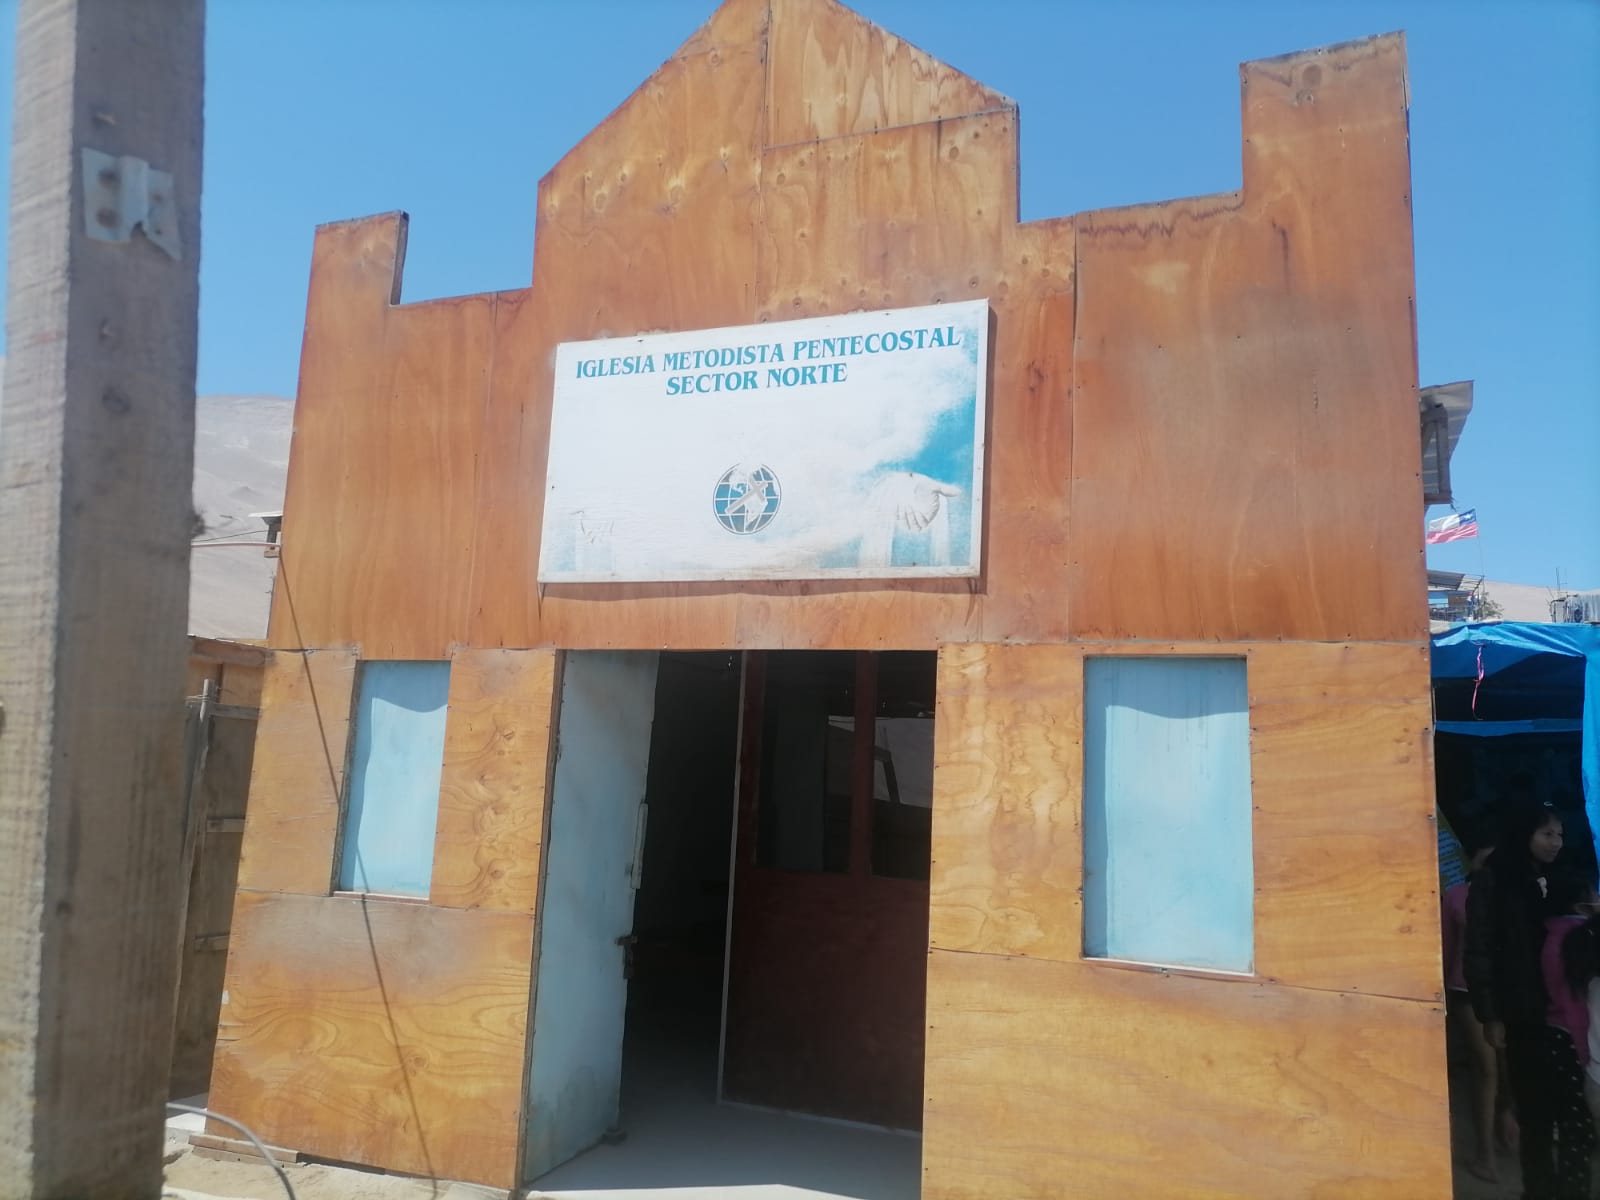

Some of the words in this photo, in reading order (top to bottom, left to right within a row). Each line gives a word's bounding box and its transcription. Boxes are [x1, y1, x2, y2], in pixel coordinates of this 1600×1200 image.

[576, 355, 655, 379] IGLESIA
[664, 344, 784, 371] METODISTA
[793, 326, 961, 361] PENTECOSTAL
[666, 370, 758, 396] SECTOR
[767, 363, 847, 388] NORTE
